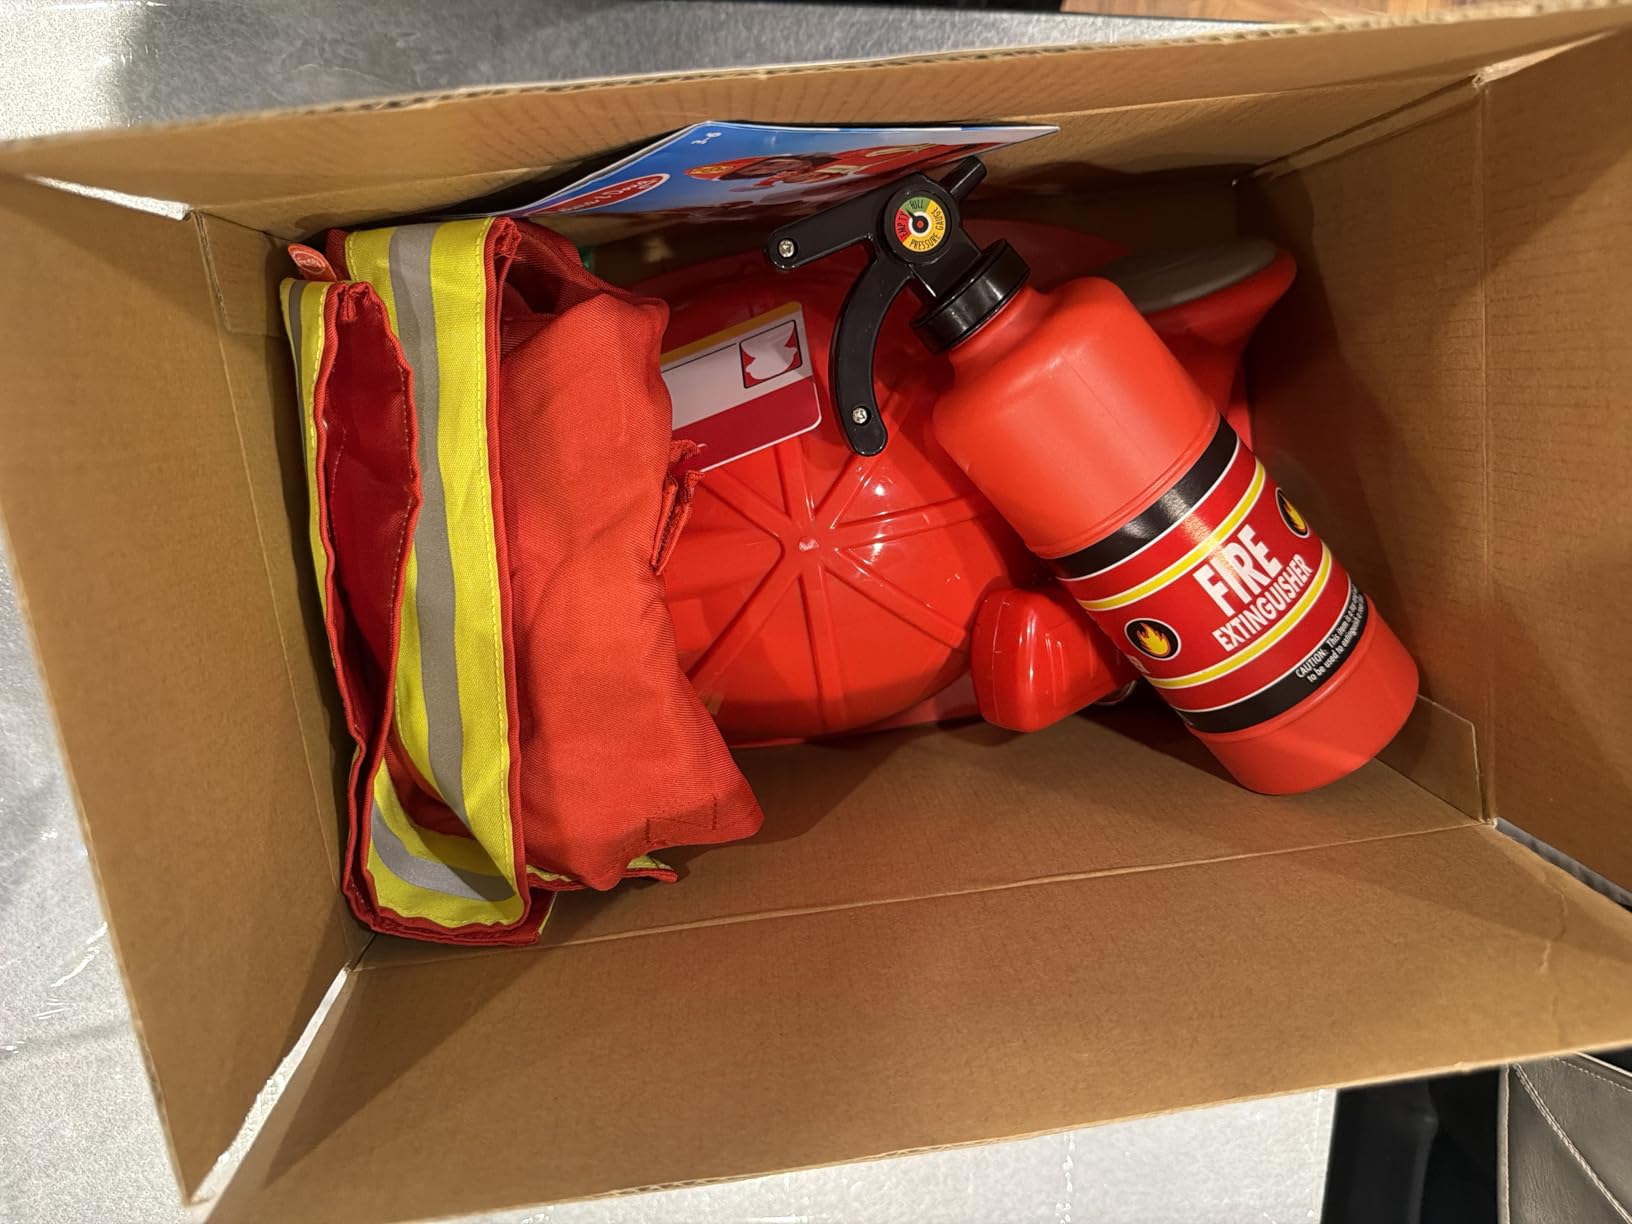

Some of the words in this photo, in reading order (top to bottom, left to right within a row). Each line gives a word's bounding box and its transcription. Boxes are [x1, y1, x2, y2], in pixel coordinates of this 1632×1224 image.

[897, 212, 908, 238] EMPTY
[909, 232, 941, 250] PRESSURE
[931, 207, 944, 231] GAUGE
[1192, 523, 1283, 618] FIRE
[1211, 553, 1313, 652] EXTINGUISHER
[1295, 648, 1328, 678] CAUTION:
[1326, 634, 1340, 648] This
[1337, 620, 1350, 636] item
[1307, 673, 1317, 683] to
[1315, 665, 1325, 676] be
[1323, 650, 1339, 668] used
[1335, 645, 1344, 655] to
